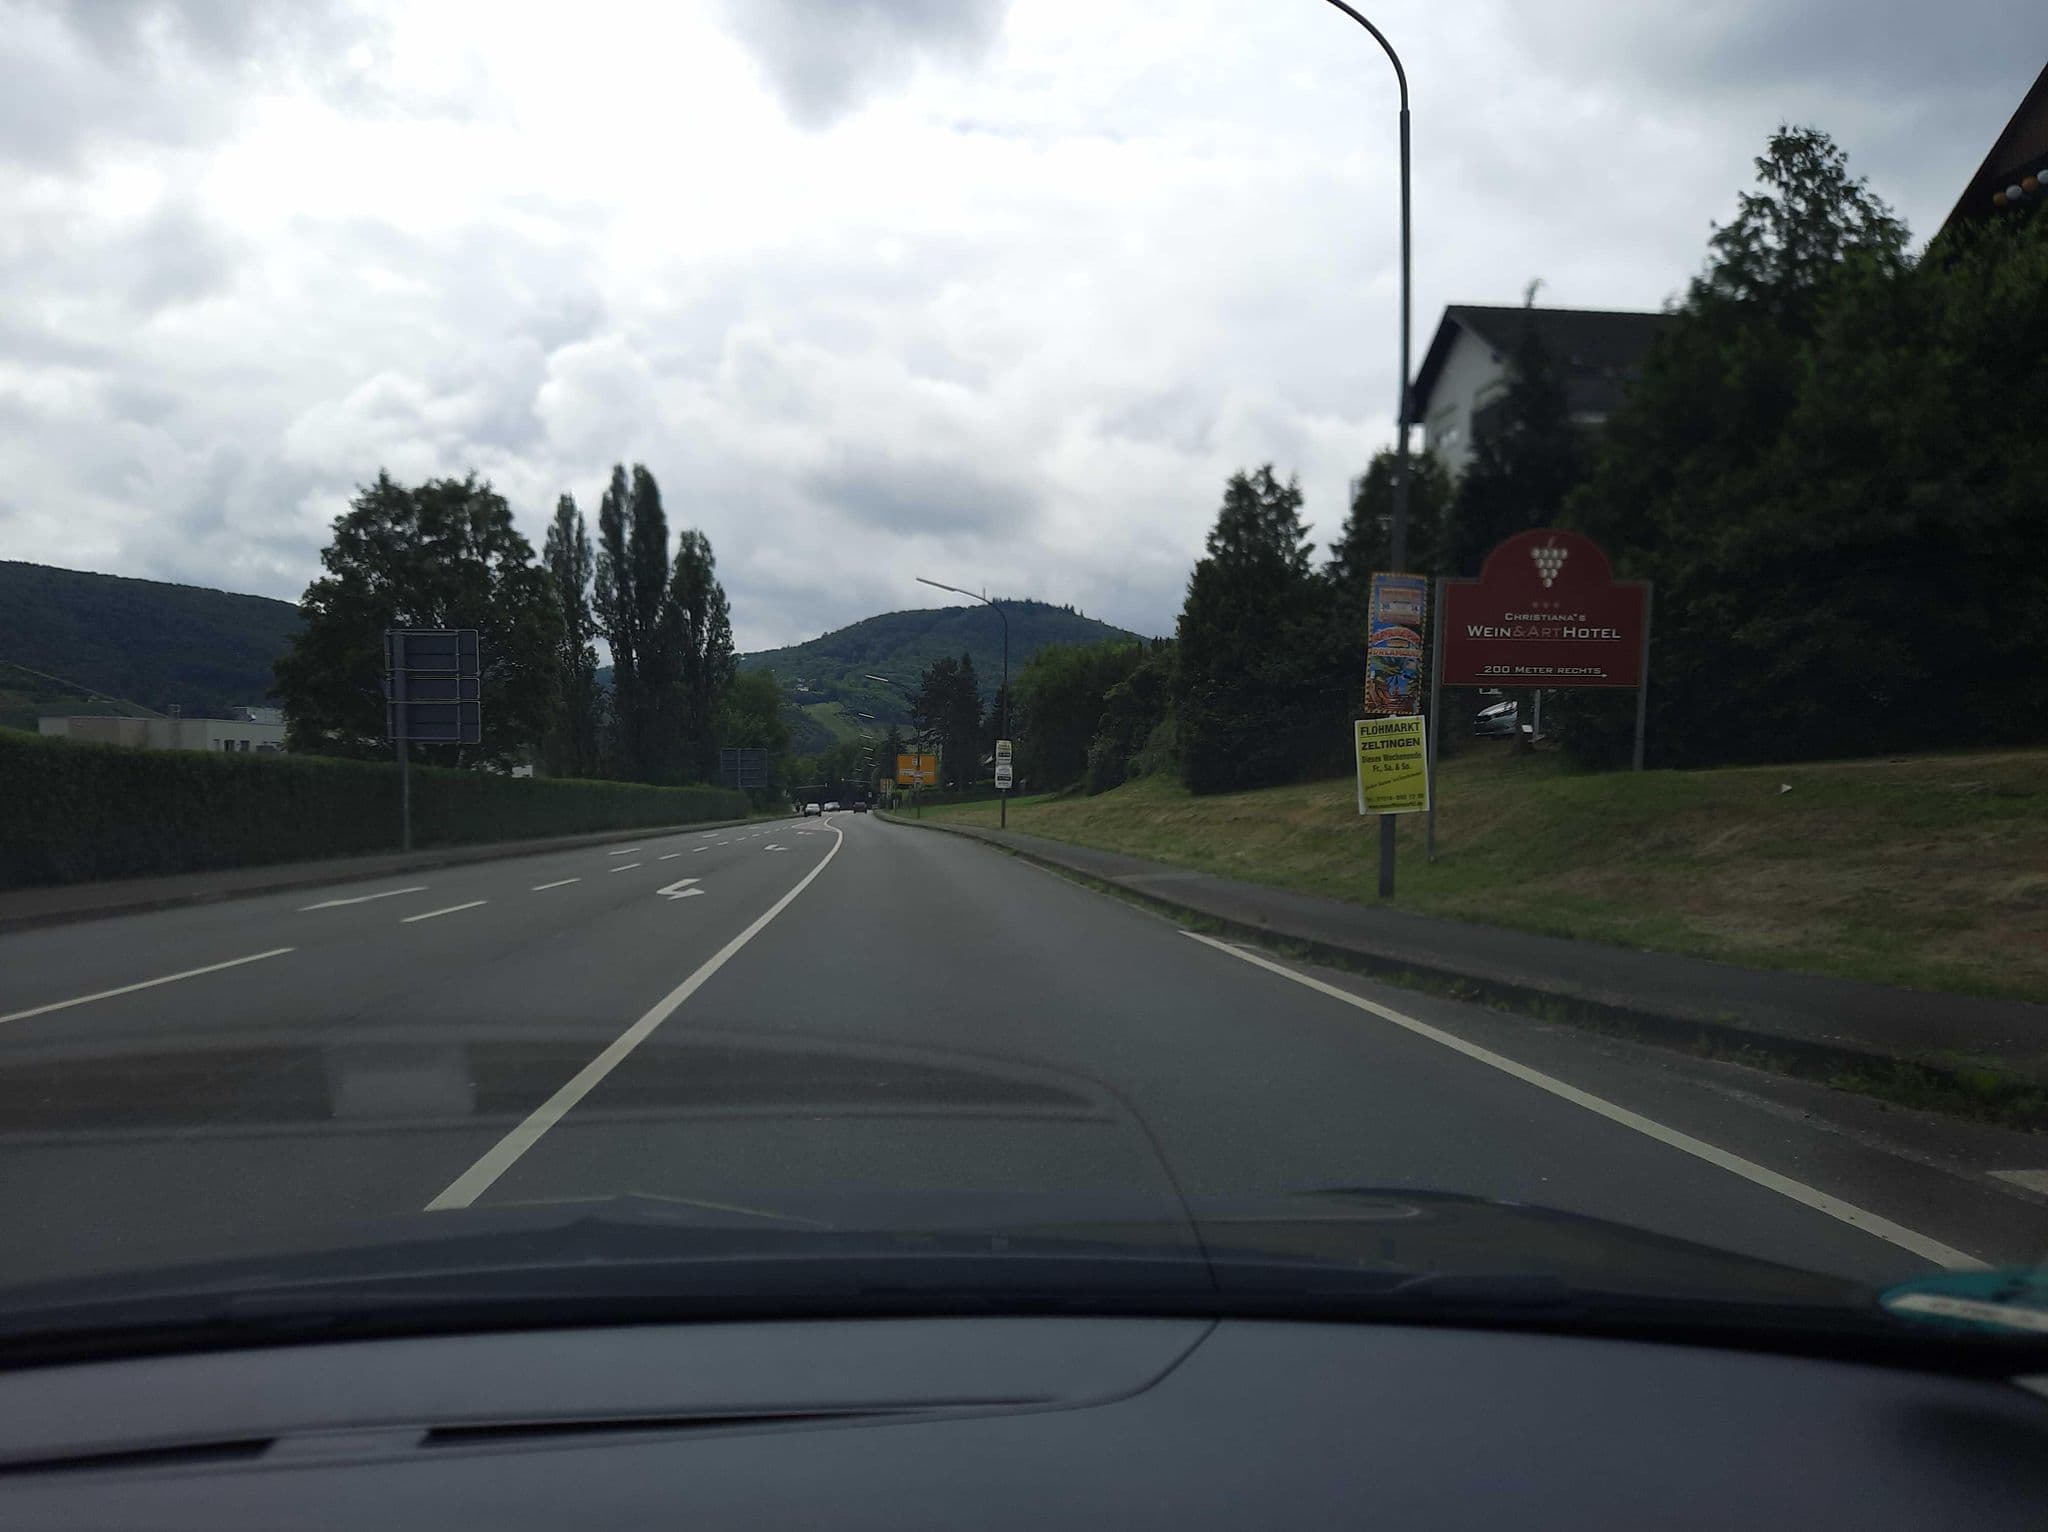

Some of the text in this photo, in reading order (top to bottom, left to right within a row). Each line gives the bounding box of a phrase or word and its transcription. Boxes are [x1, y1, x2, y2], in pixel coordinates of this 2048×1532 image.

[1484, 665, 1601, 675] 200 METER RECHTS
[1360, 721, 1421, 736] FLOHMARKT
[1361, 737, 1420, 751] ZELTINGEN
